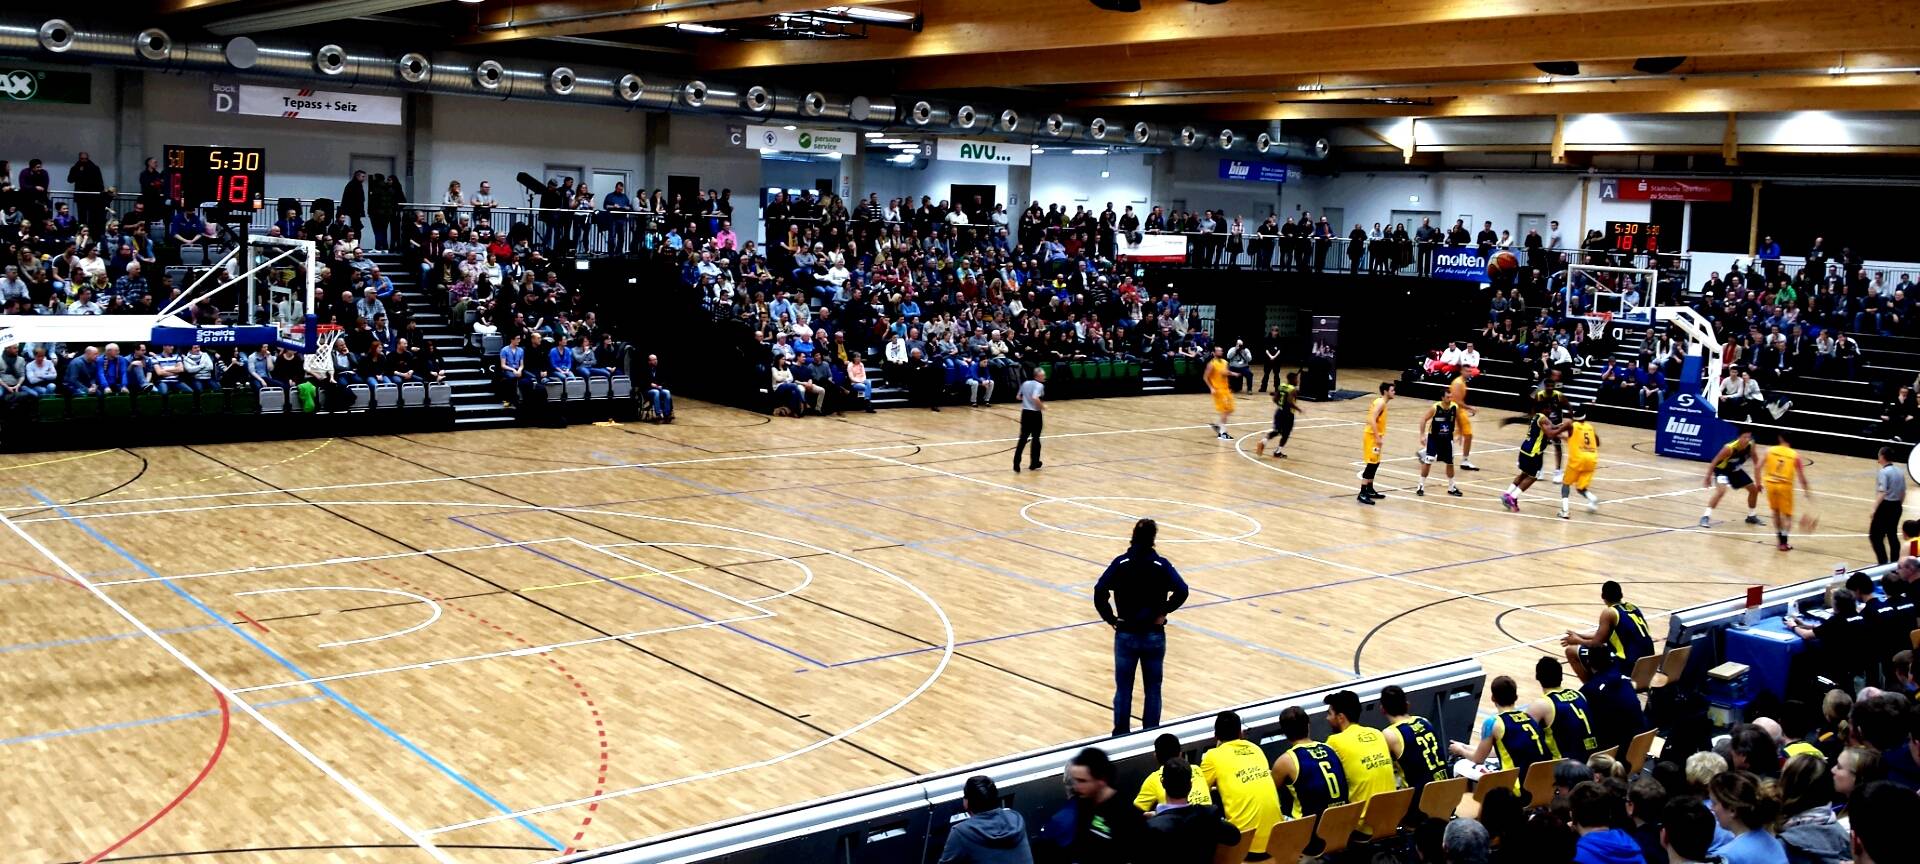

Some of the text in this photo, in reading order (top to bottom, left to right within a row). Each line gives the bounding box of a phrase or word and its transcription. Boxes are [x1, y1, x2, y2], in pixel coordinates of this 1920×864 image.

[216, 93, 232, 112] D
[283, 97, 322, 110] Tepass
[335, 101, 357, 112] Seiz
[731, 133, 741, 149] C
[814, 135, 840, 144] persona
[814, 143, 837, 151] service
[925, 145, 932, 156] B
[209, 151, 259, 171] 5:30
[216, 175, 248, 203] 18
[1603, 185, 1614, 198] A
[1614, 223, 1639, 235] 5:30
[1617, 236, 1633, 250] 18
[1437, 253, 1485, 268] molten
[1665, 416, 1702, 436] biw
[1584, 433, 1590, 445] 5
[1570, 702, 1592, 734] 4
[1522, 723, 1544, 755] 7
[1416, 732, 1445, 770] 22
[1319, 761, 1340, 798] 6
